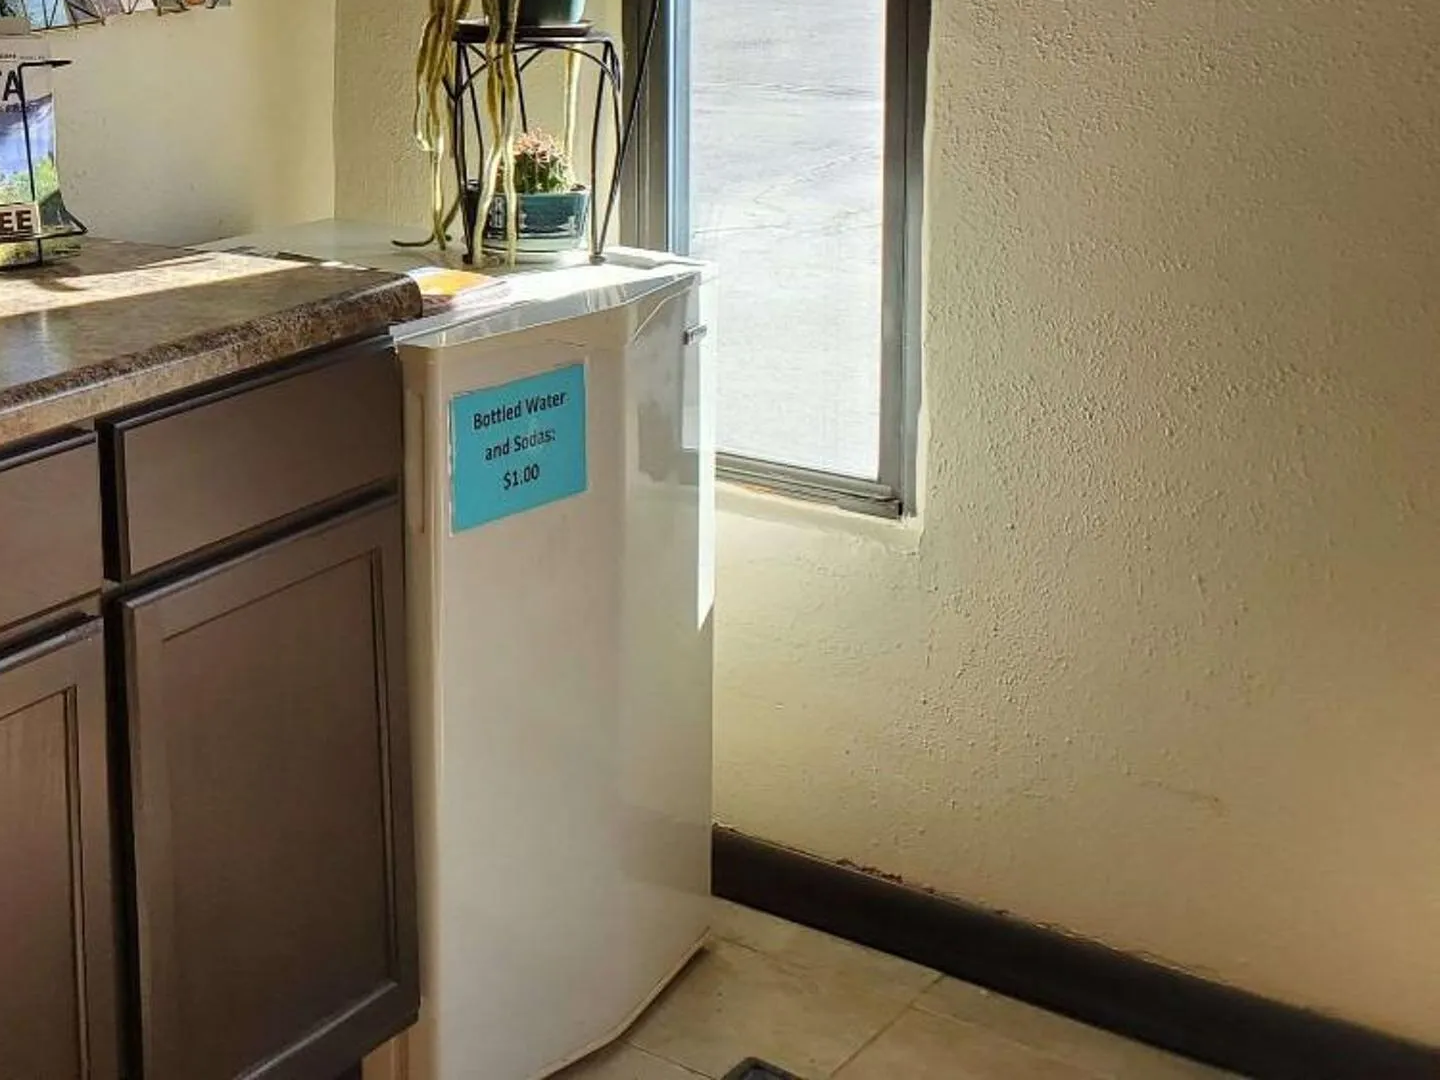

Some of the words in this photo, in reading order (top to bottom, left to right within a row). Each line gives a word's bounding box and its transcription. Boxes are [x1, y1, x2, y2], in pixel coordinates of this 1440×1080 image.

[473, 400, 522, 430] Bottled
[524, 391, 567, 415] Water
[485, 436, 510, 461] and
[503, 463, 540, 491] $1.00
